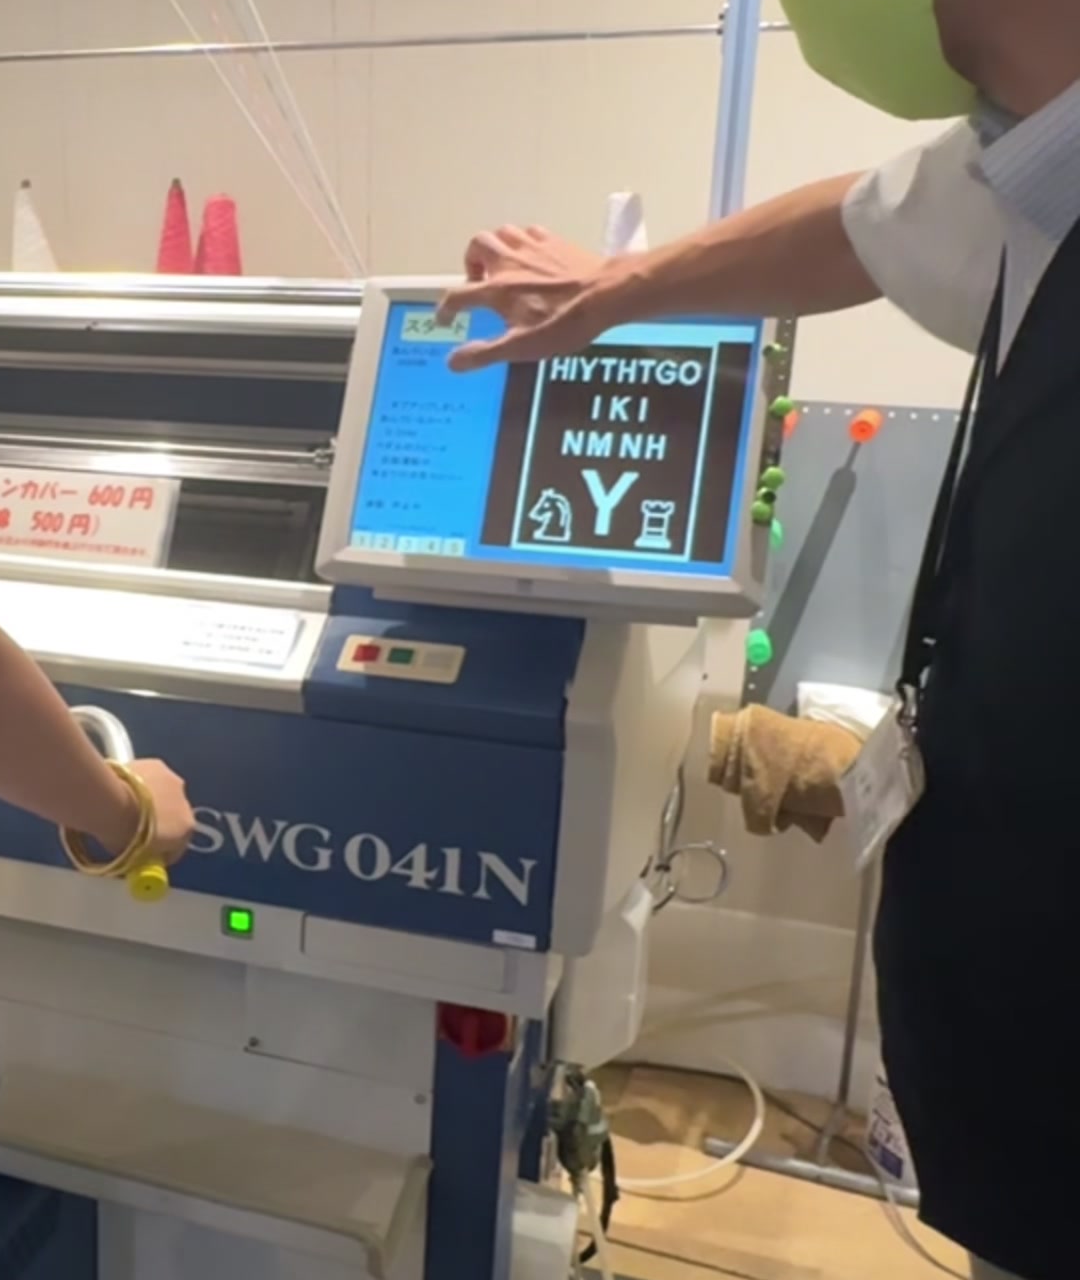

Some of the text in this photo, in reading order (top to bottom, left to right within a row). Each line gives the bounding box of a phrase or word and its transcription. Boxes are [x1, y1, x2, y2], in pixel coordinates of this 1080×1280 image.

[405, 318, 465, 335] スタト
[550, 356, 703, 386] HIYTHTGO
[581, 469, 640, 536] Y
[188, 807, 538, 906] SWG041N
